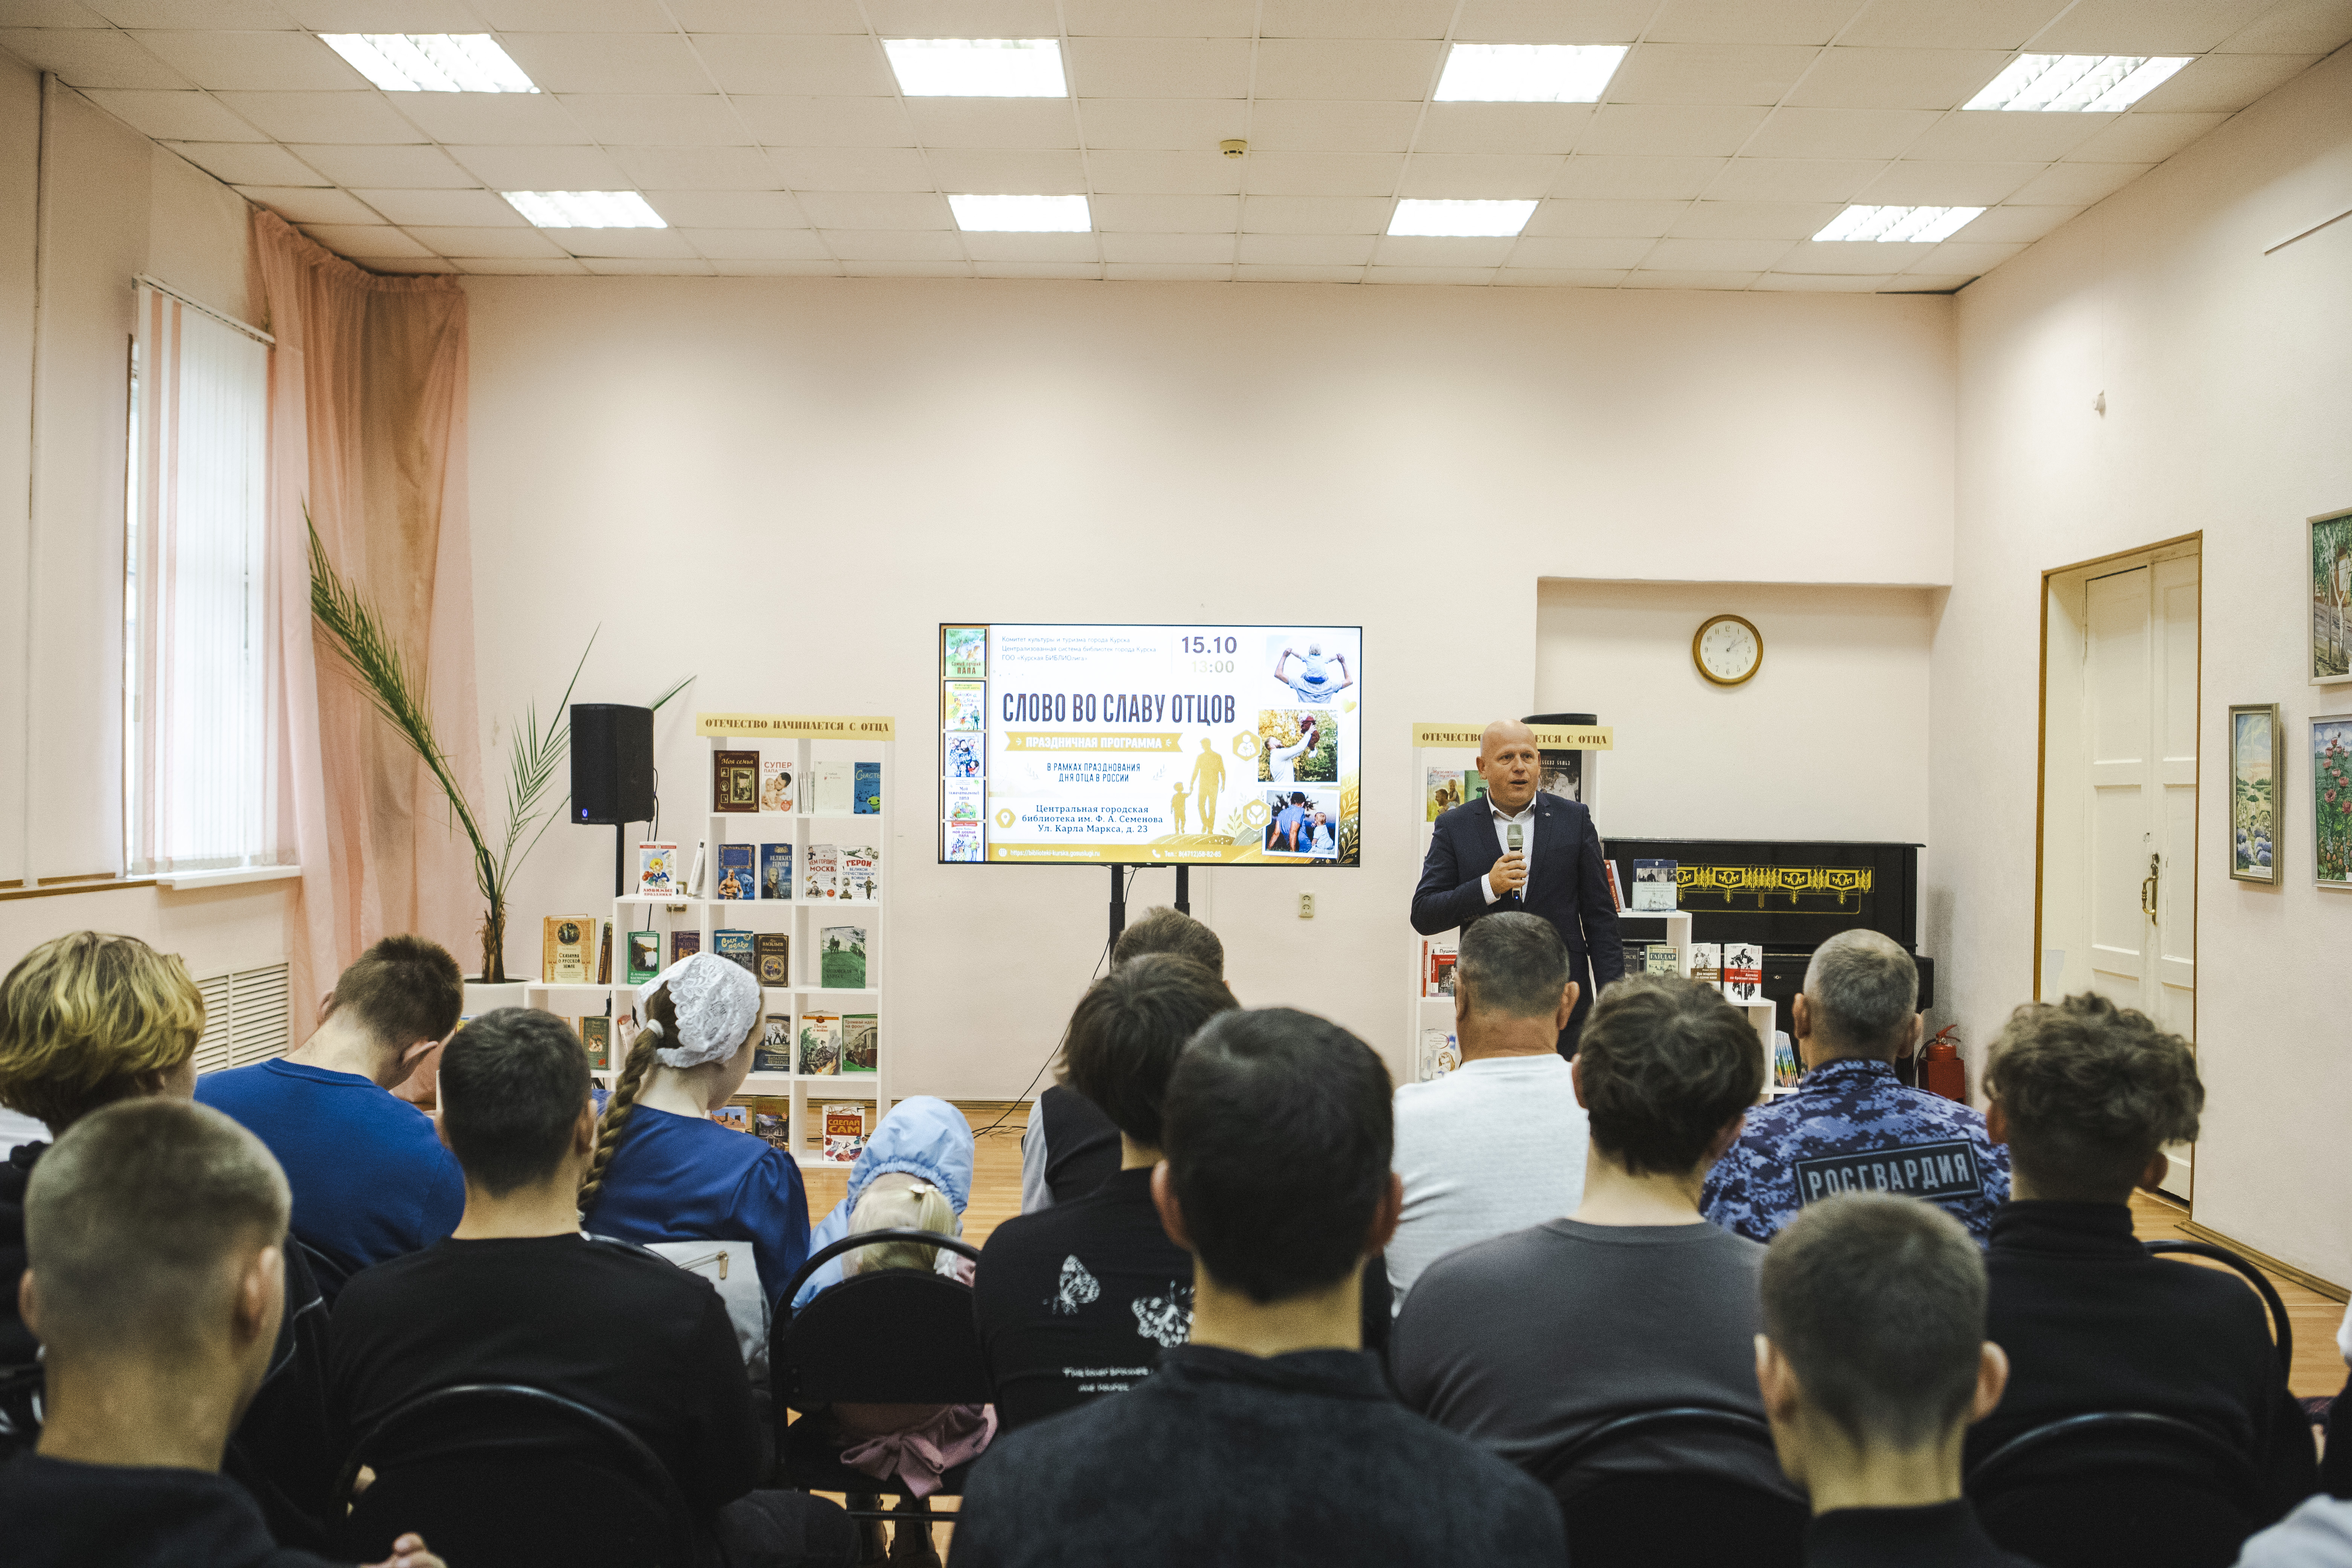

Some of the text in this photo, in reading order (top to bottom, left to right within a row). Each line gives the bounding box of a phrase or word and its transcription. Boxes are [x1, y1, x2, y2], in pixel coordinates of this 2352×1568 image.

[1182, 636, 1237, 654] 15.10
[1744, 657, 1748, 665] 4
[1191, 660, 1234, 673] 13:00
[1003, 693, 1235, 727] СЛОВО ВО СЛАВУ ОТЦОВ
[705, 718, 889, 732] ОТЕЧЕСТВО НАЧИНАЕТСЯ С ОТЦА
[1026, 737, 1162, 749] ПРАЗДНИЧНАЯ ПРОГРАММА
[1579, 735, 1607, 745] ОТЦА
[1047, 763, 1141, 772] В РАМКАХ ПРАЗДНОВАНИЯ
[1058, 773, 1129, 783] ДНЯ ОТЦА В РОССИИ
[1036, 804, 1098, 813] Центральная
[1095, 815, 1105, 823] Ф.
[1119, 815, 1163, 823] Семенова
[1038, 824, 1052, 833] Ул.
[1055, 825, 1084, 834] Карла
[1086, 825, 1124, 835] Маркса,
[1010, 849, 1101, 858] https://biblioteki-kurska.gosuslugi.ru
[721, 937, 737, 948] Сын
[828, 1125, 860, 1134] САМ
[1806, 1153, 1971, 1201] РОСГВАРДИЯ
